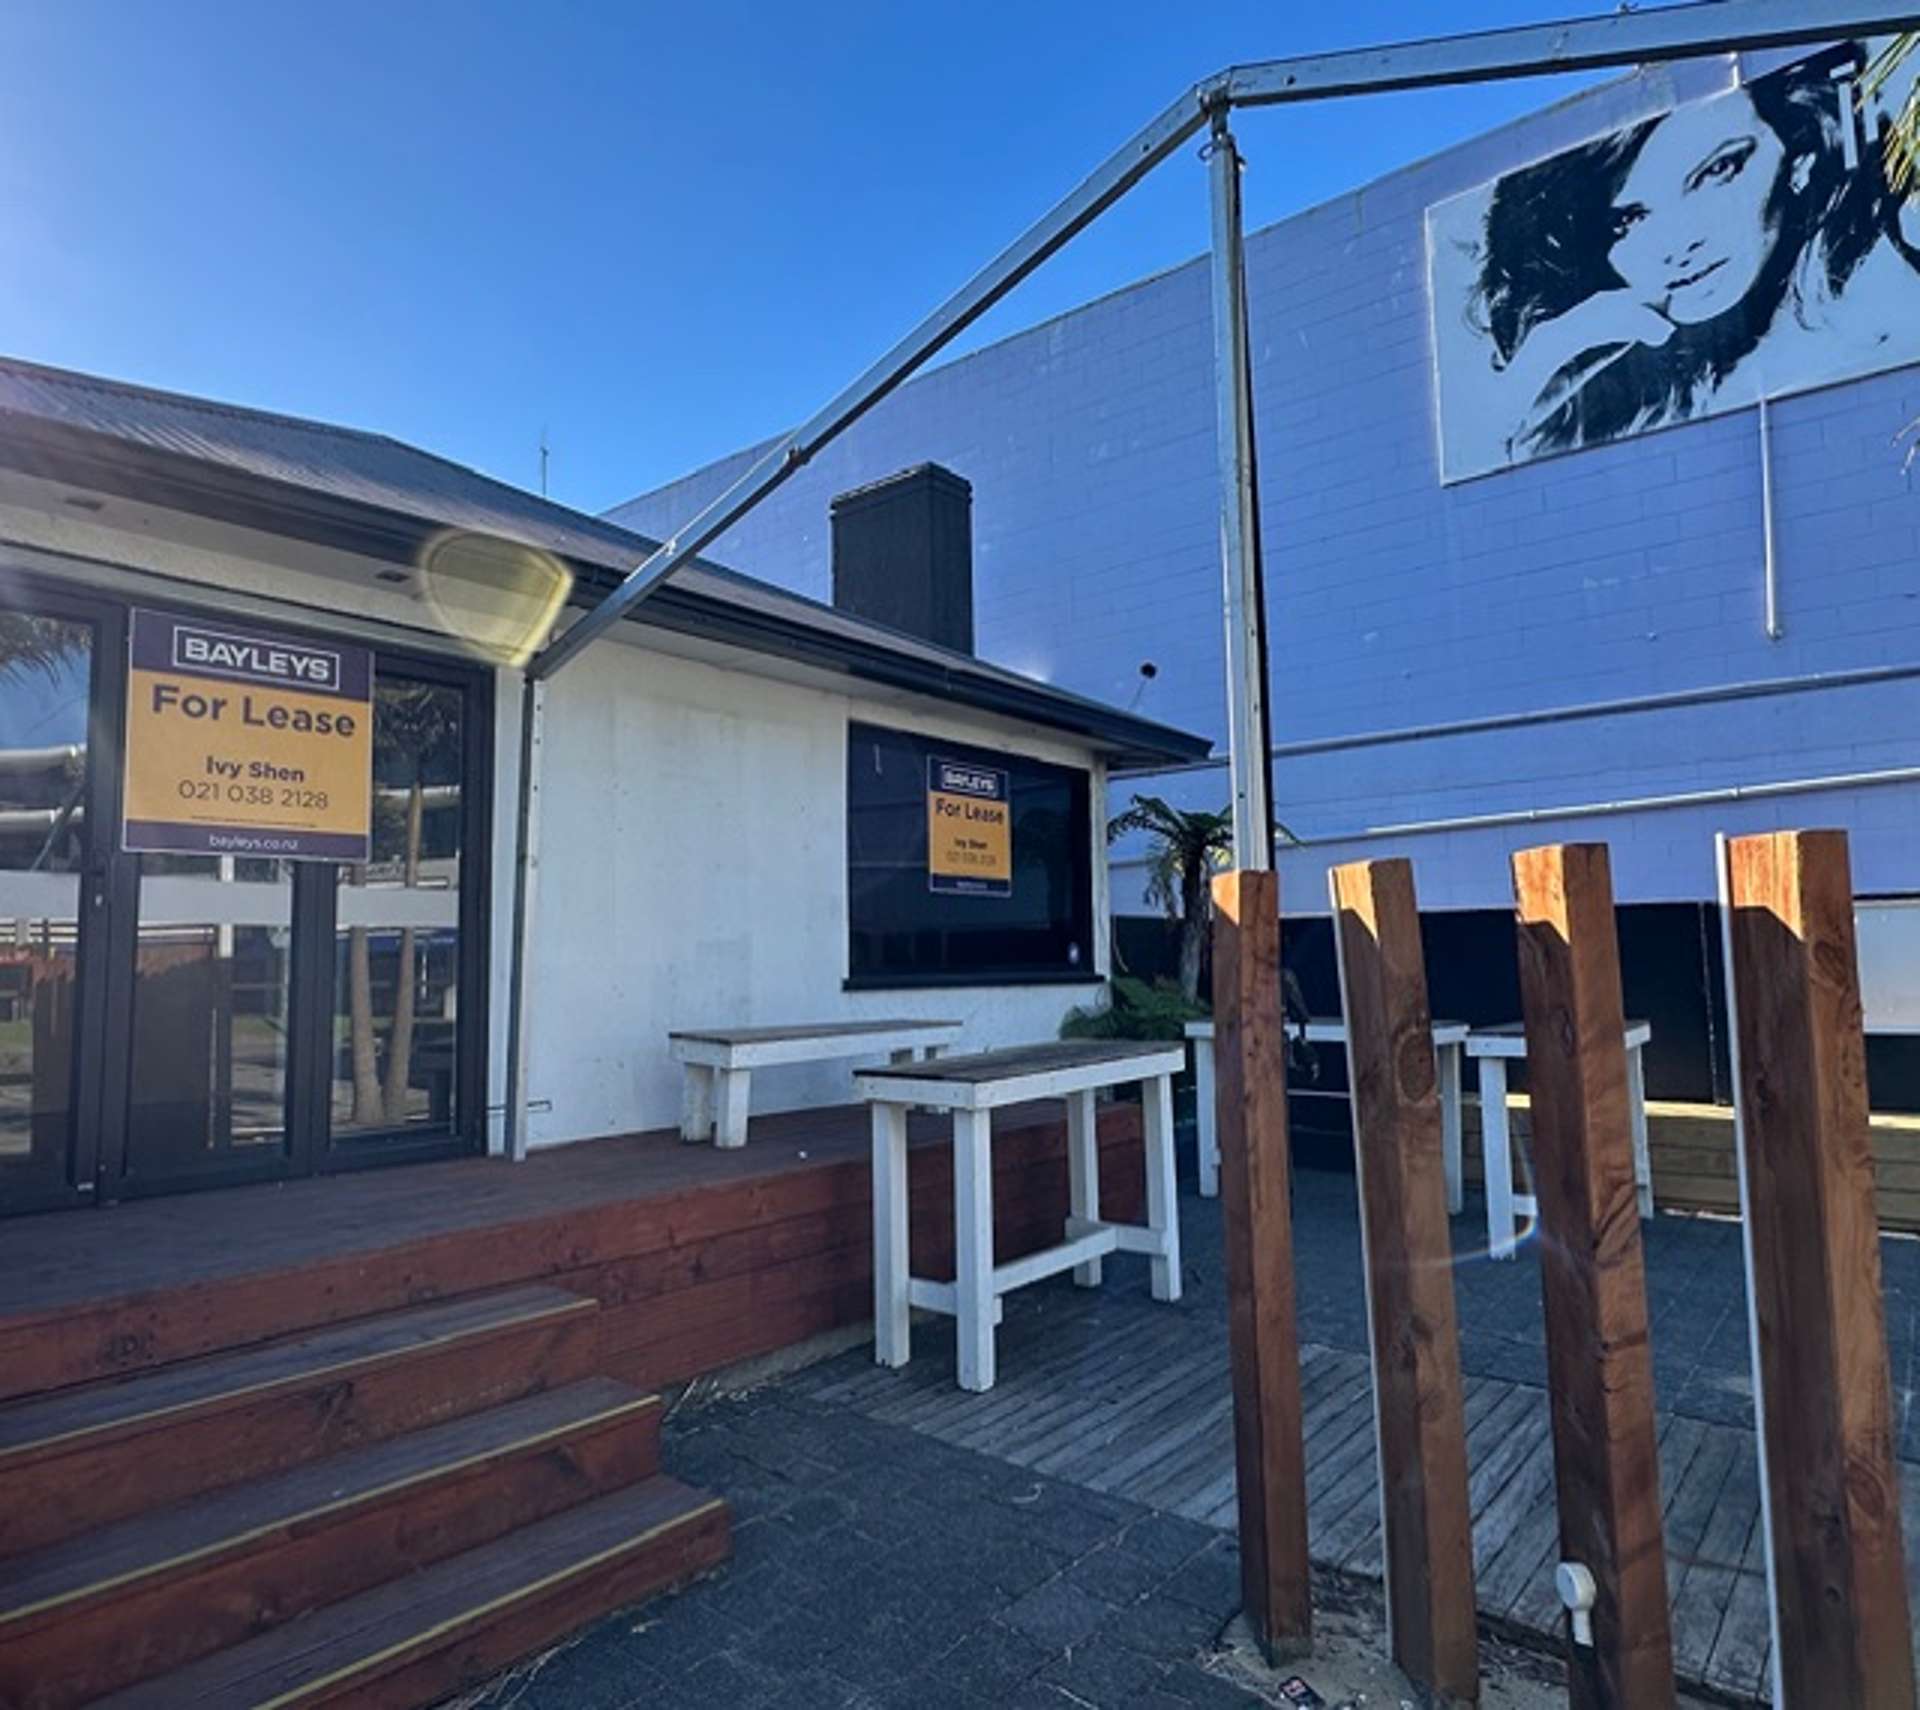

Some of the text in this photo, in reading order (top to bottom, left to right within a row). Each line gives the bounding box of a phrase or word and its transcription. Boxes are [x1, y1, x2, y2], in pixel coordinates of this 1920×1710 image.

[184, 638, 329, 680] BAYLEYS
[153, 684, 355, 736] For Lease
[206, 755, 304, 782] Ivy Shen
[178, 779, 328, 810] 021 038 2128
[936, 798, 1003, 824] For Lease
